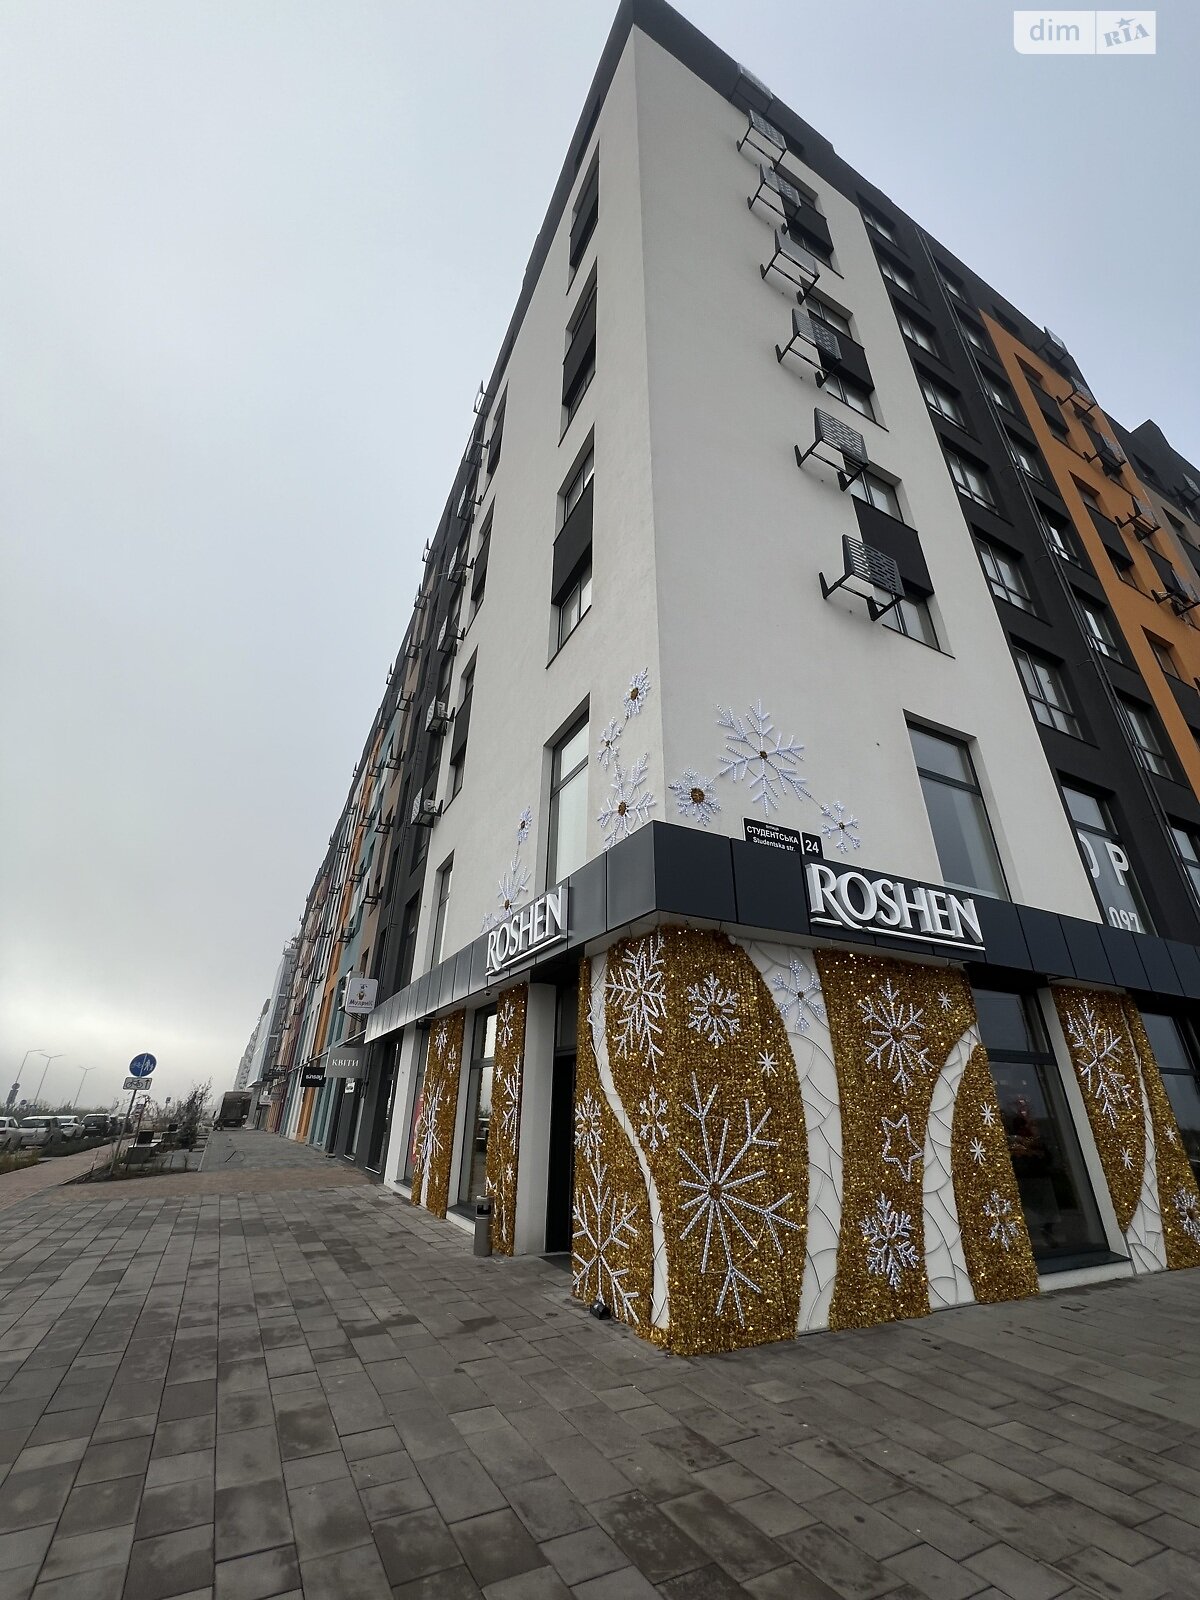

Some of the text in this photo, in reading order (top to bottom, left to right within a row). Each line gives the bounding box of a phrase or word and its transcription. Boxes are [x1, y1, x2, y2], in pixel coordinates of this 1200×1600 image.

[746, 825, 800, 845] СТУДЕНТСЬКА
[752, 836, 797, 852] Studentska str.
[805, 839, 820, 854] 24
[804, 862, 984, 944] ROSHEN
[486, 884, 568, 972] ROSHEN
[331, 1059, 359, 1067] КВІТИ
[305, 1073, 323, 1081] sinsay
